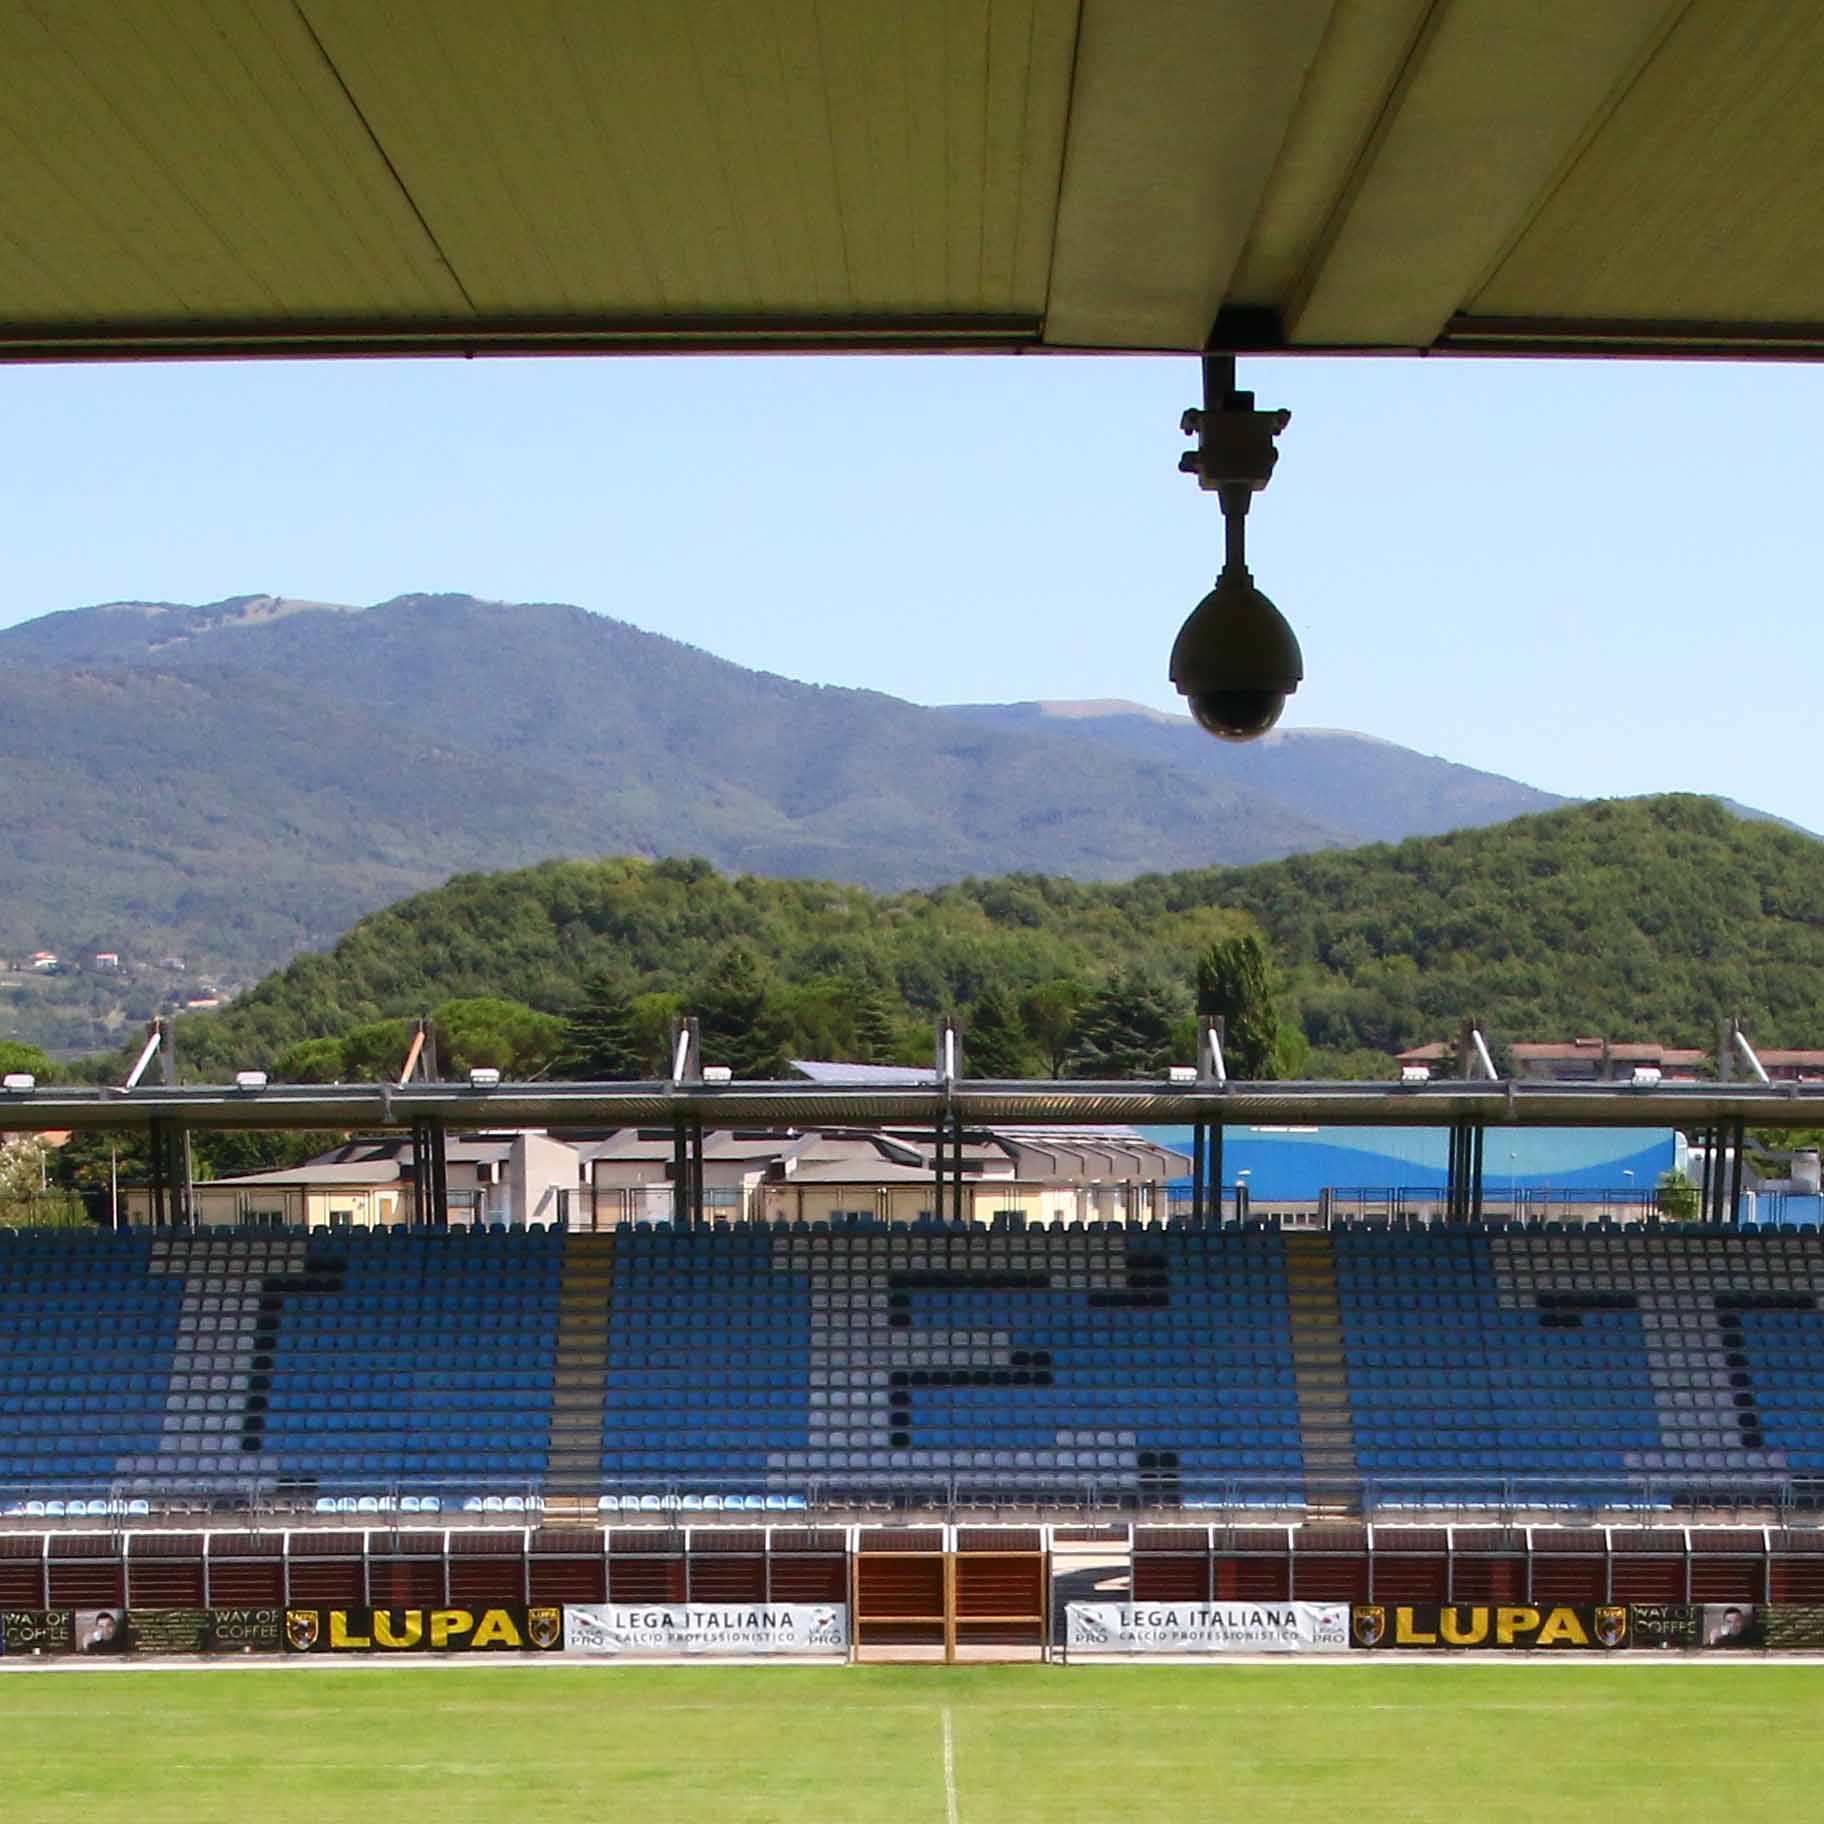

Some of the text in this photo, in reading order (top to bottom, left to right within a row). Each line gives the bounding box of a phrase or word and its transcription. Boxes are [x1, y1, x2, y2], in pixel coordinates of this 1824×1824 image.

[216, 1610, 278, 1623] WAY OF
[1120, 1611, 1297, 1626] LEGA ITALIANA
[1633, 1607, 1668, 1618] WAY
[6, 1613, 40, 1625] WA
[616, 1612, 793, 1628] LEGA ITALIANA
[216, 1625, 278, 1638] COFFEE
[330, 1609, 523, 1647] LUPA
[1396, 1607, 1589, 1644] LUPA
[571, 1635, 604, 1645] PRO
[615, 1632, 795, 1642] CALCIO PROFESSIONISTICO
[1076, 1634, 1108, 1644] PRO
[1119, 1631, 1299, 1640] CALCIO PROFESSIONISTICO
[1313, 1634, 1345, 1643] PRO
